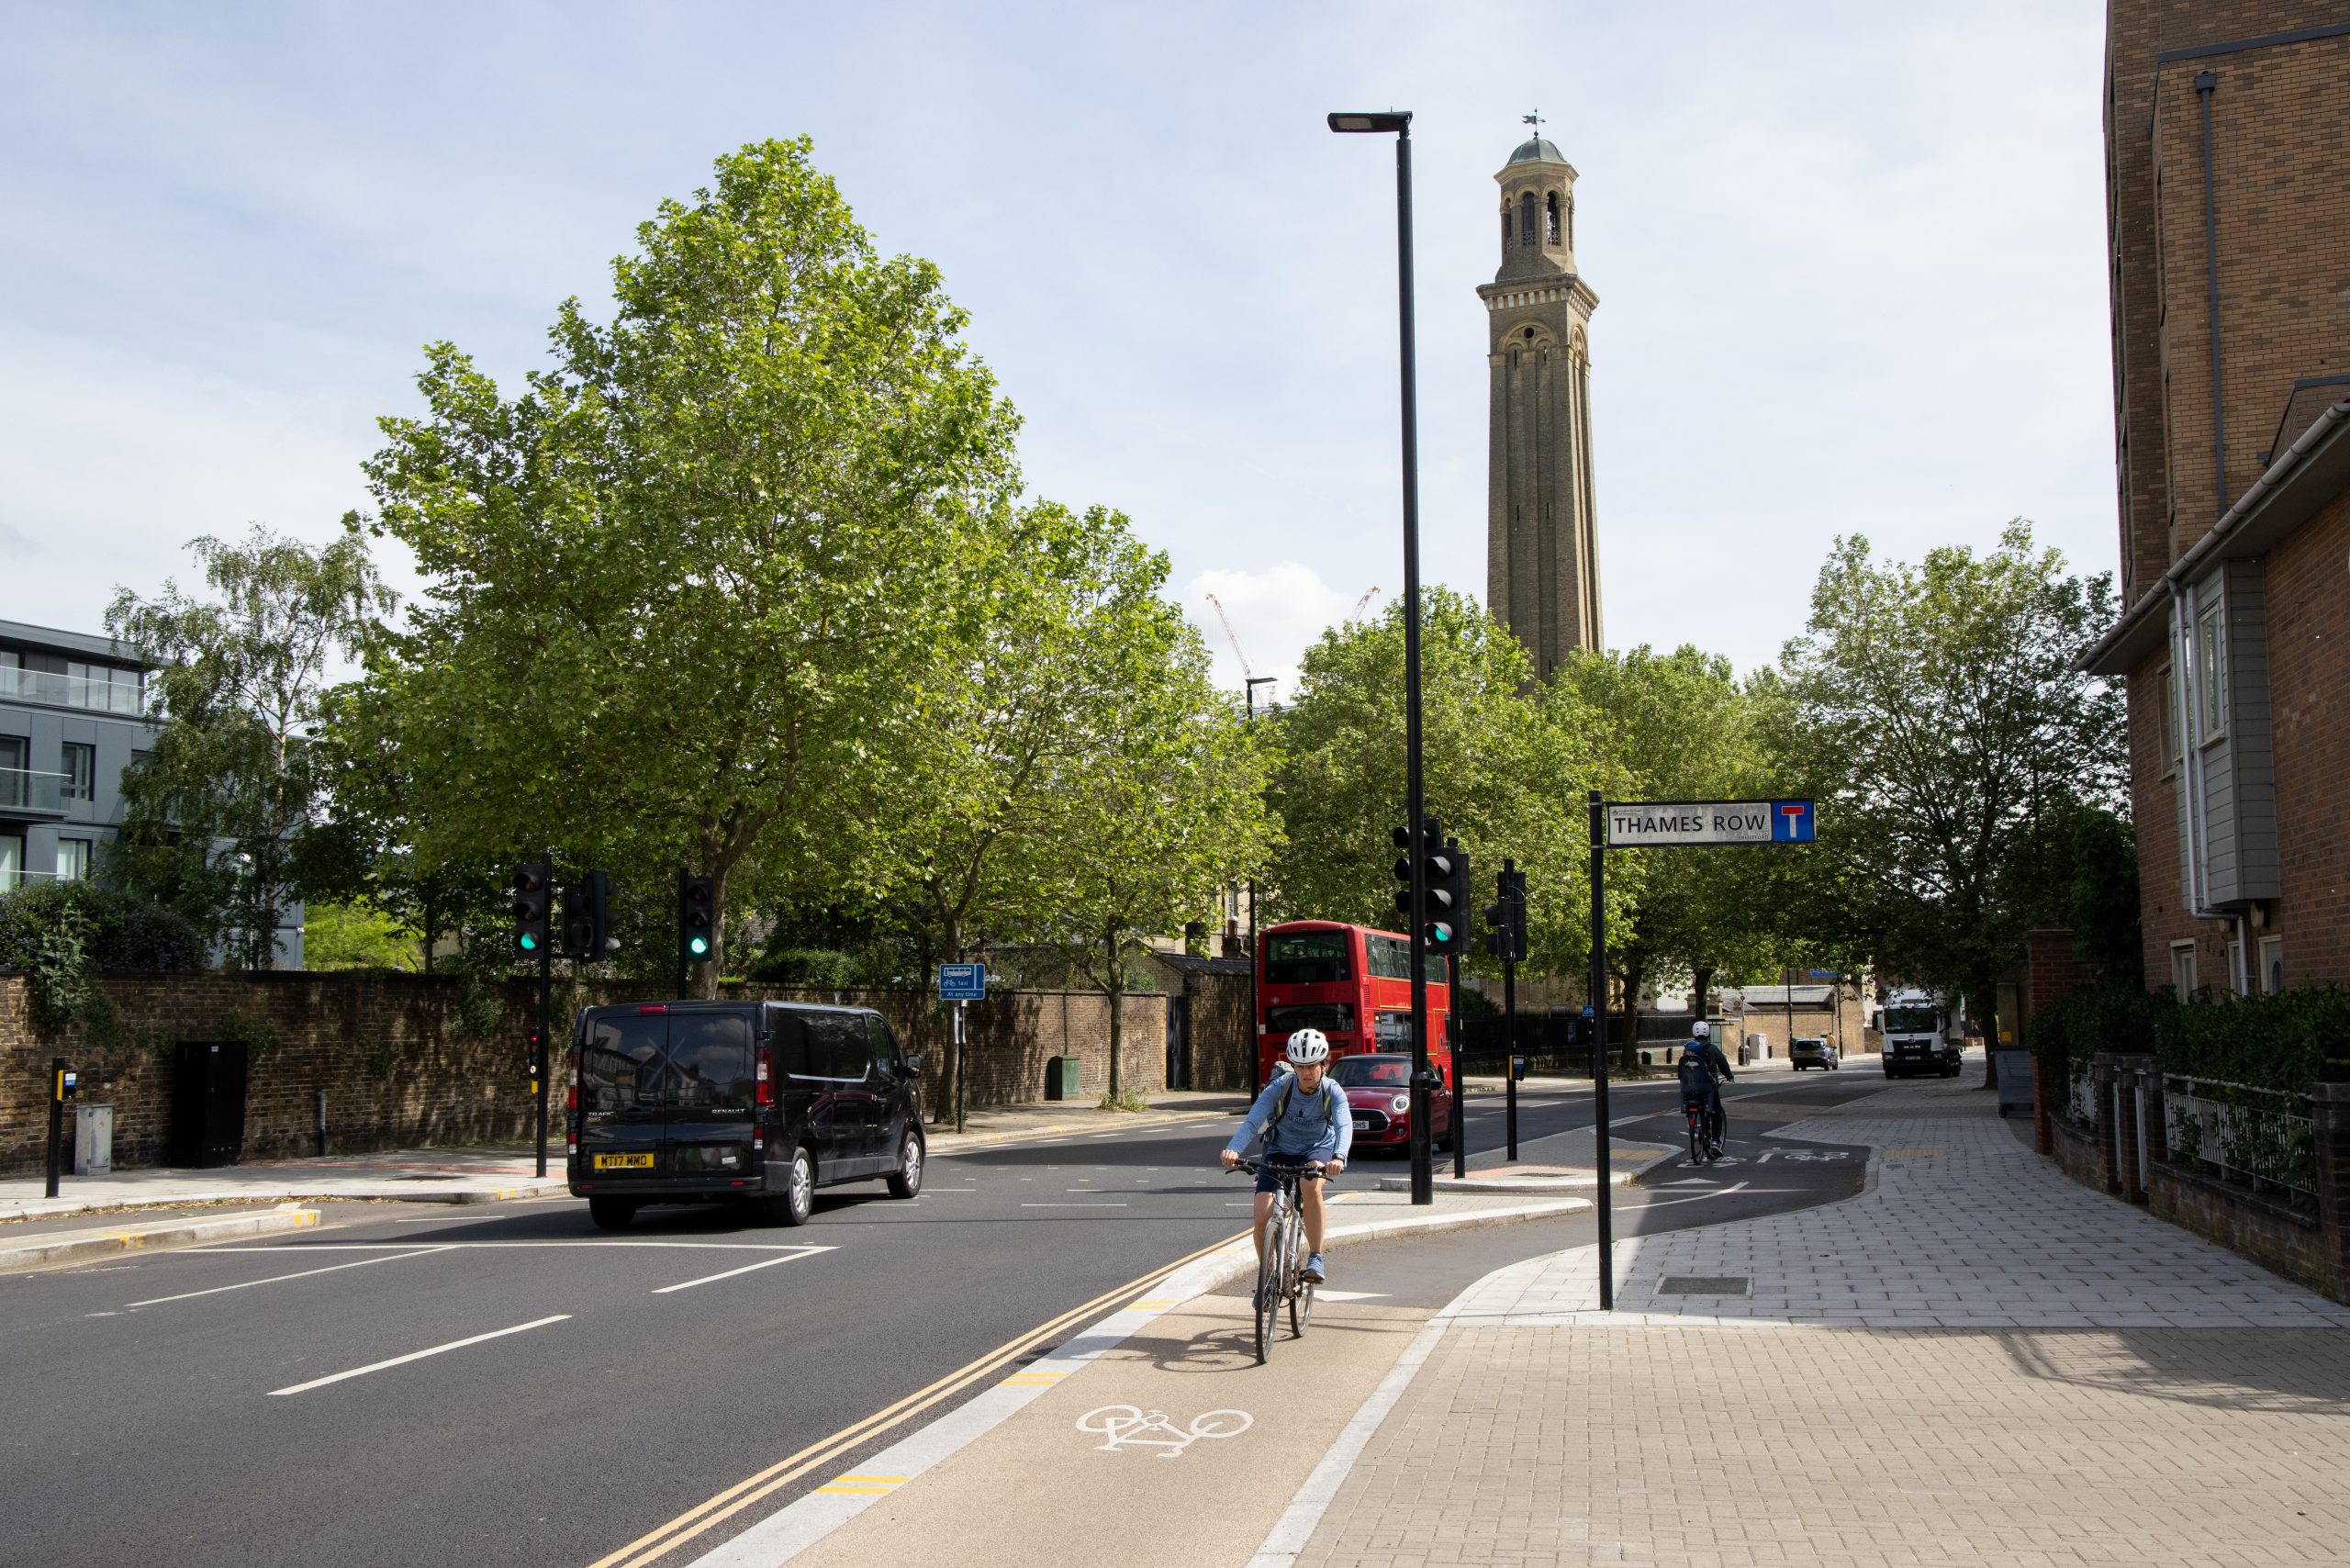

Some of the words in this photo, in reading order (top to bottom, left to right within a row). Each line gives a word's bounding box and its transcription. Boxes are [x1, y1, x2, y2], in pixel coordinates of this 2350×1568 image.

[1614, 817, 1703, 833] THAMES
[1714, 815, 1766, 831] ROW
[601, 1156, 624, 1166] MT17
[626, 1155, 647, 1166] MMO
